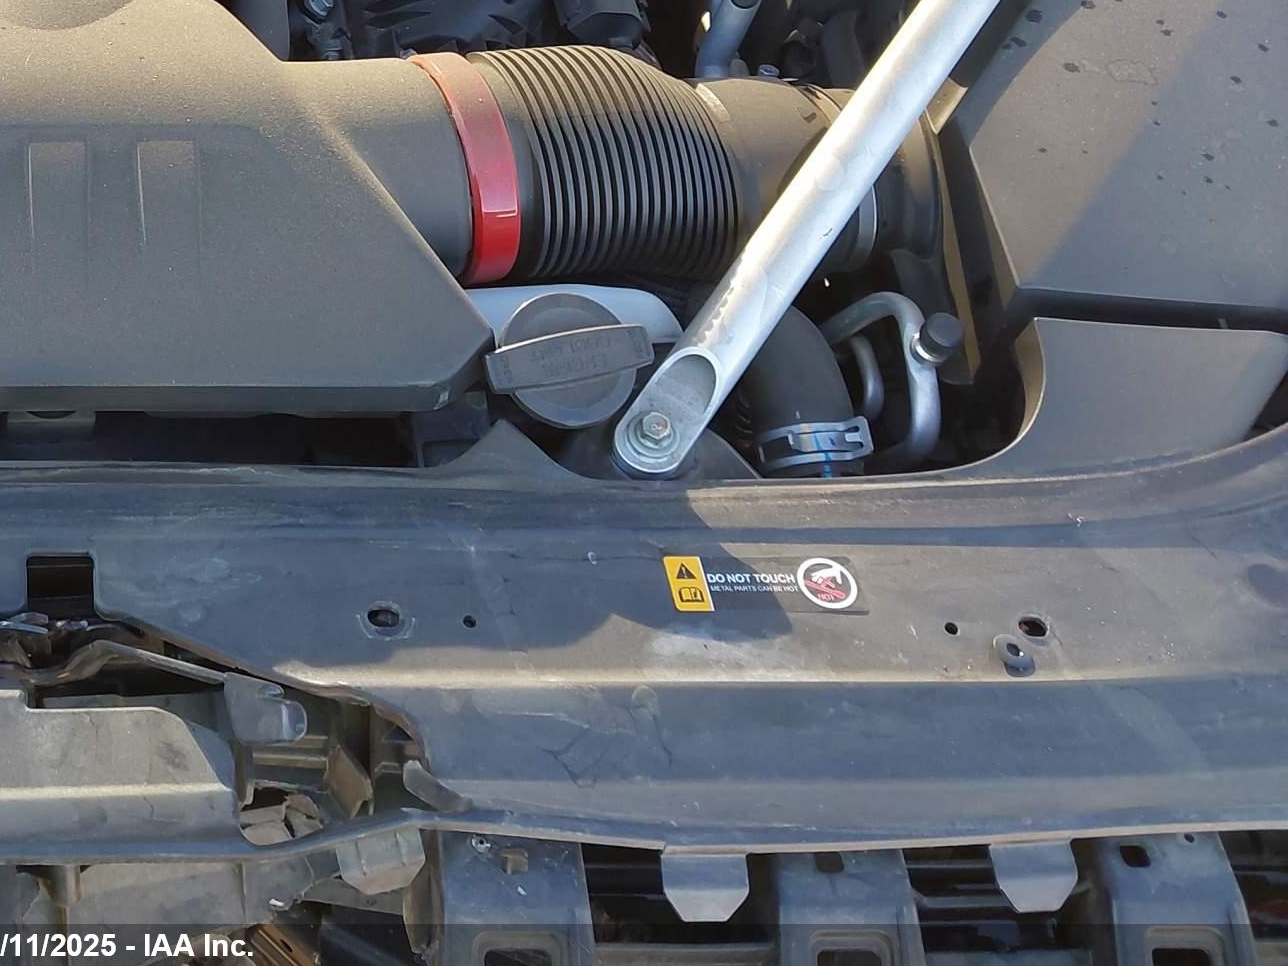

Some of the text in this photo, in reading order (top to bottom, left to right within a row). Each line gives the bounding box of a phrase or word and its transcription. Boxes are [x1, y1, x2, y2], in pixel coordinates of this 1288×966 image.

[707, 573, 795, 583] DO NOT TOUCH
